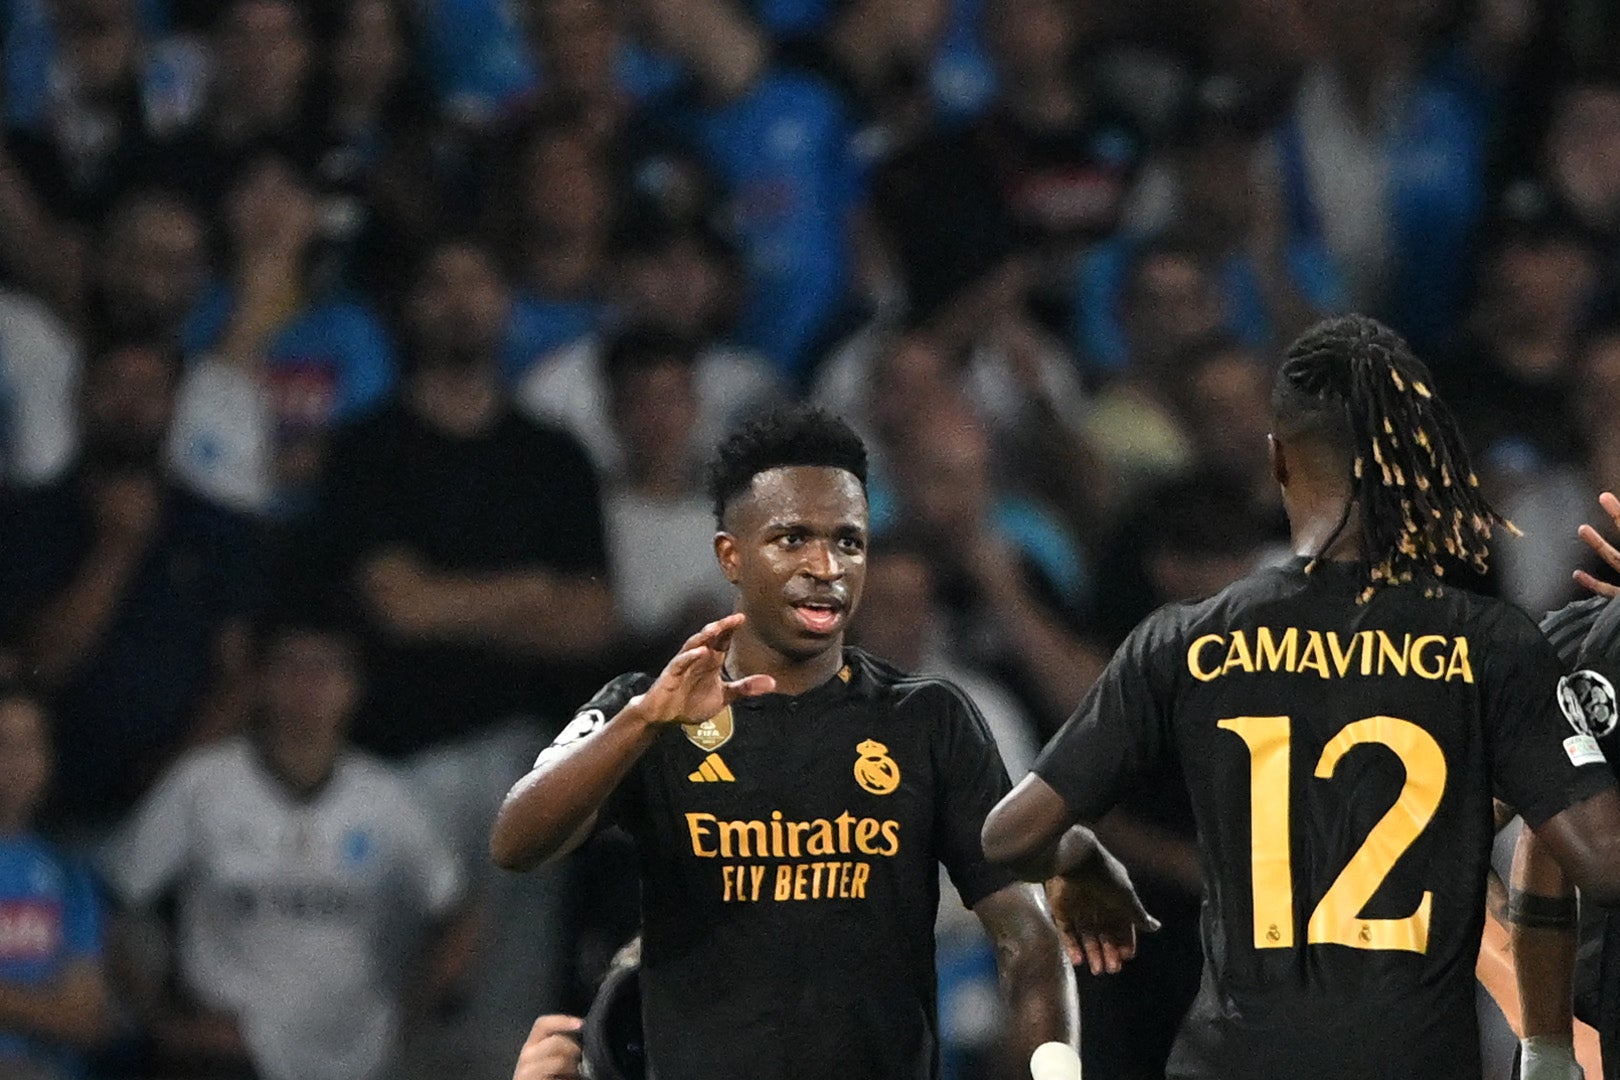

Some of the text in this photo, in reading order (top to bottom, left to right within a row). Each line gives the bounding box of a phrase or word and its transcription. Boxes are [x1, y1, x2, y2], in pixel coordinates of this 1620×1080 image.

[1187, 627, 1475, 684] CAMAVINGA
[697, 729, 720, 737] FIFA
[684, 810, 901, 858] Emirates
[1217, 716, 1448, 955] 12
[722, 861, 870, 901] FLY BETTER
